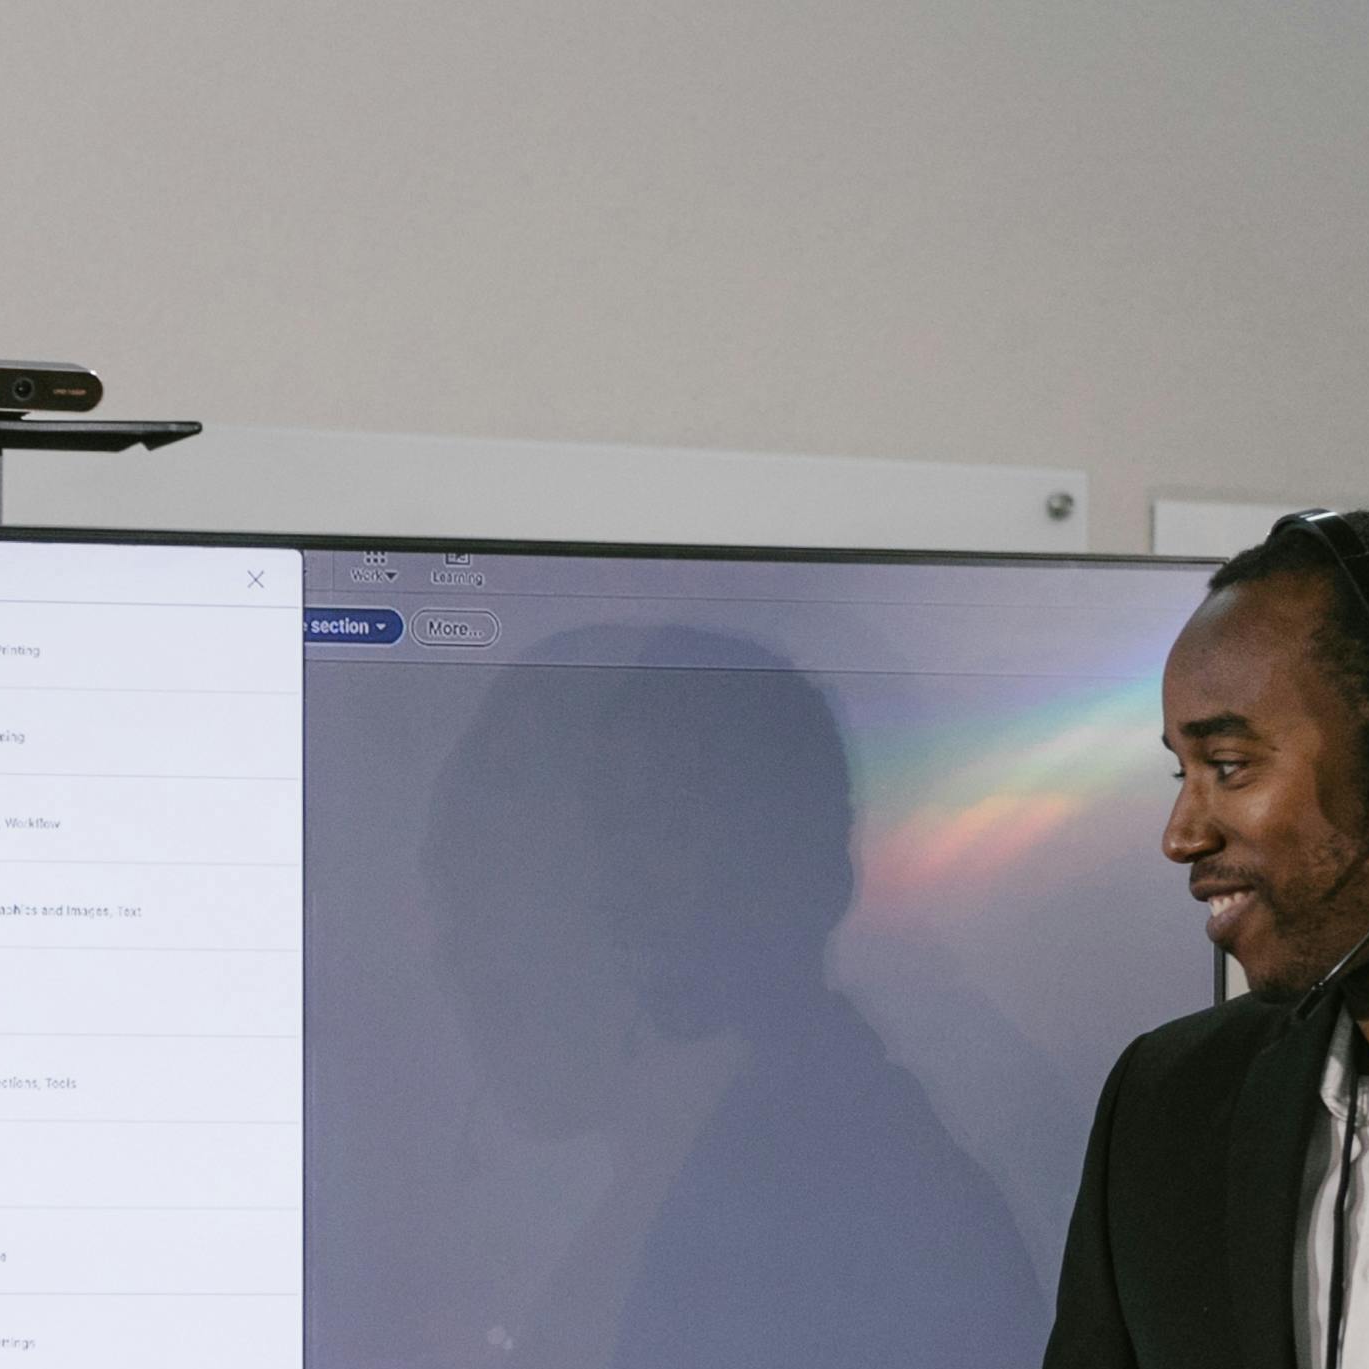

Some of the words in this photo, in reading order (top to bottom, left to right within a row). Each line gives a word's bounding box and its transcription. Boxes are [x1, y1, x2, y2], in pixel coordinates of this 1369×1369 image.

[351, 568, 383, 582] Work
[431, 570, 484, 586] Learning
[311, 619, 369, 635] section
[428, 621, 483, 636] More...
